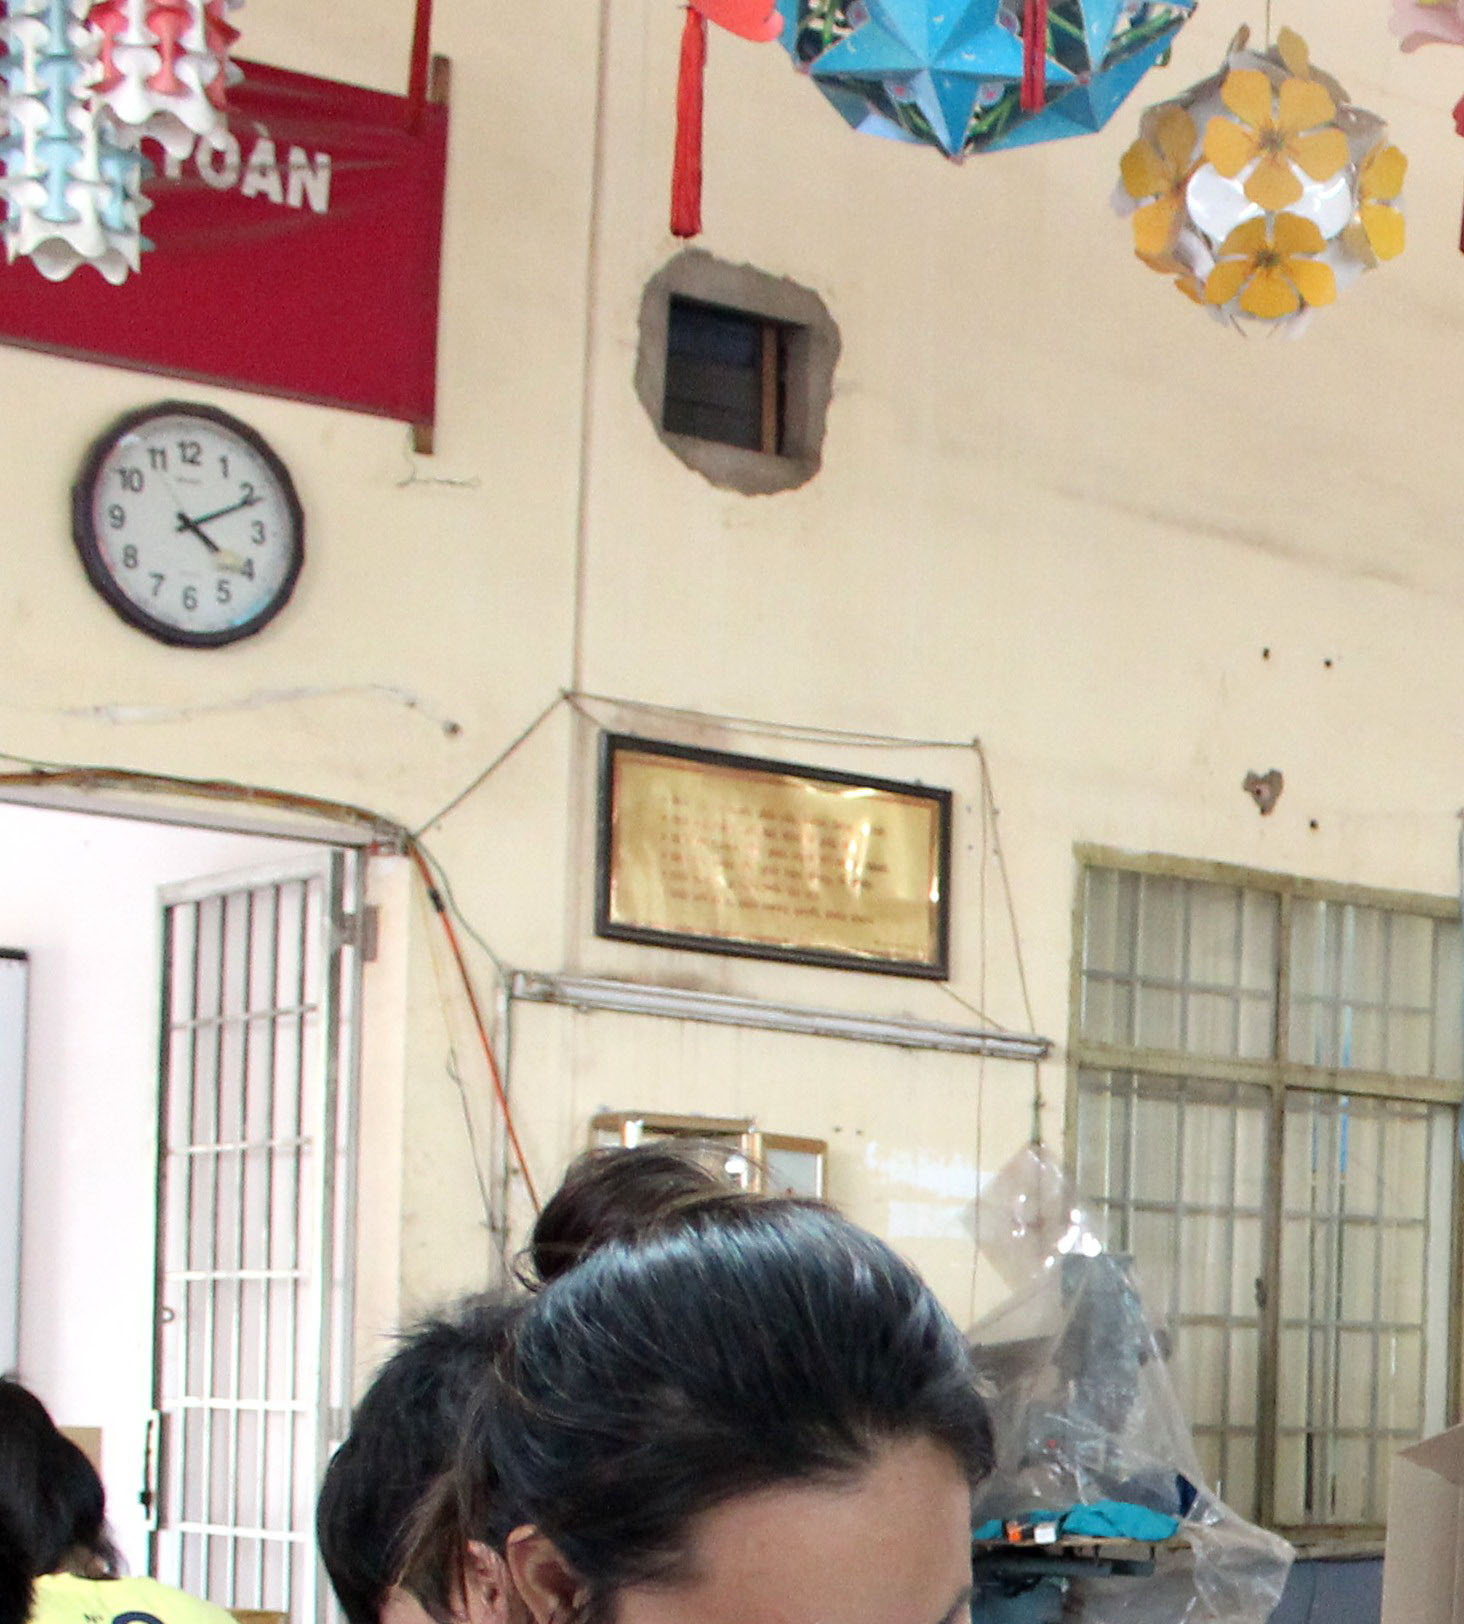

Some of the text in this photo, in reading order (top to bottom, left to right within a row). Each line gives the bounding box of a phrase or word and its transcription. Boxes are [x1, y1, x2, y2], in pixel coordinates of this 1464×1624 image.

[147, 447, 168, 471] 11
[179, 440, 201, 466] 12
[114, 466, 145, 493] 10
[219, 455, 229, 479] 1
[108, 503, 126, 529] 9
[251, 520, 266, 545] 3
[122, 544, 138, 569] 8
[150, 571, 166, 596] 7
[216, 579, 232, 604] 5
[182, 585, 199, 610] 6
